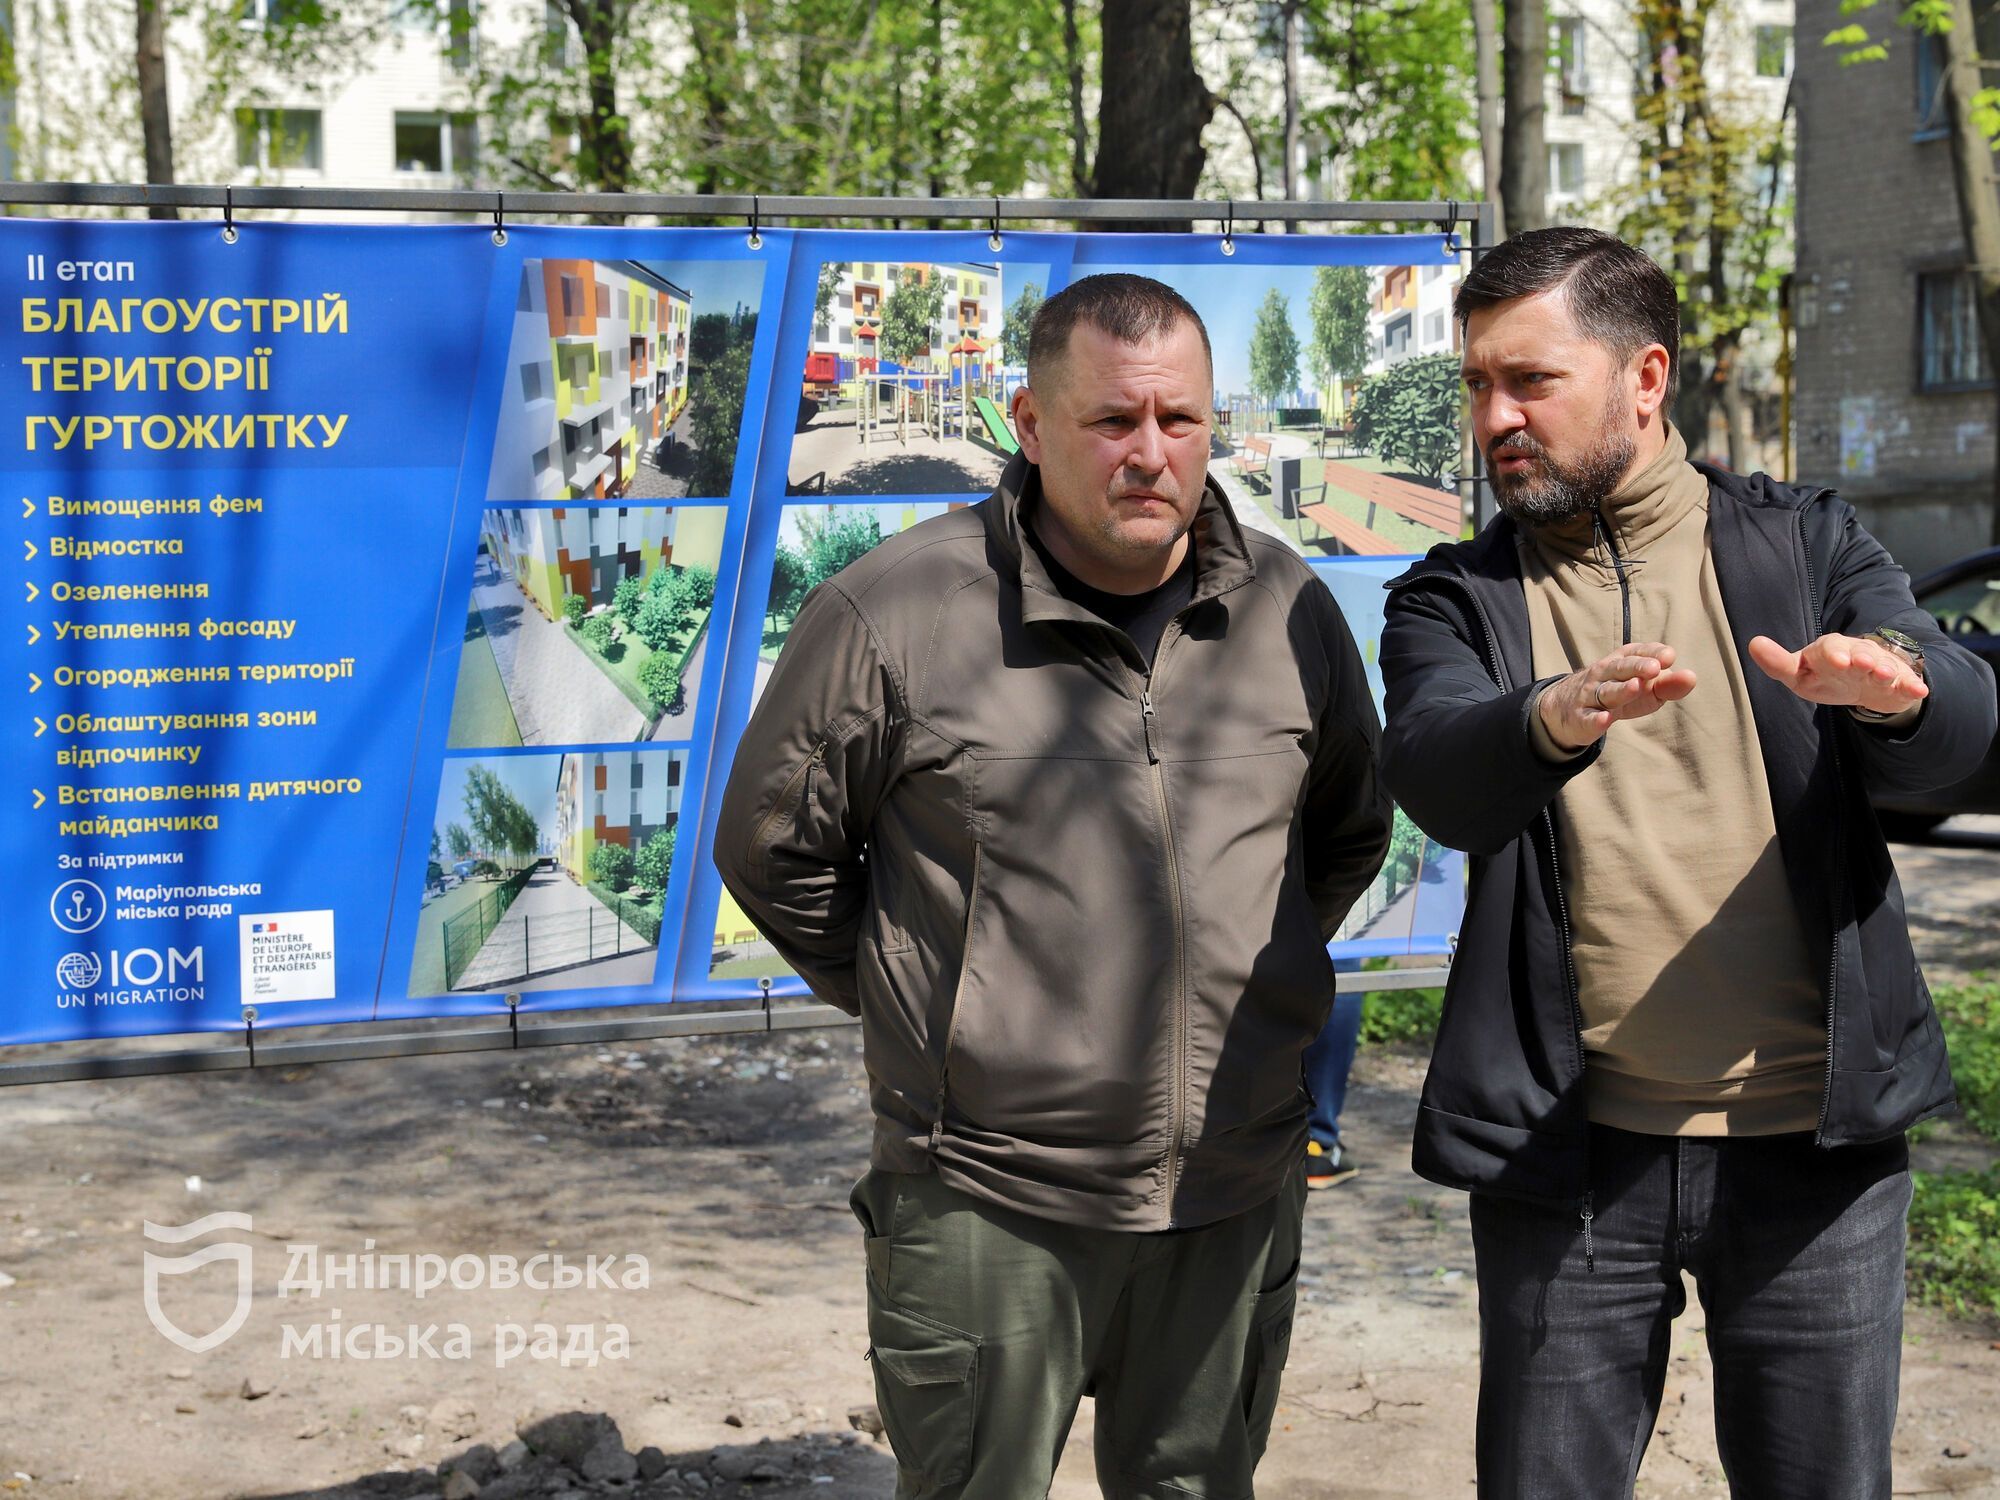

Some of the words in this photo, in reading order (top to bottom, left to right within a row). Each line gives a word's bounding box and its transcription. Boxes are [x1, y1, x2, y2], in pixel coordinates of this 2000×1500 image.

[57, 260, 135, 282] етап
[22, 293, 348, 334] БЛАГОУСТРІЙ
[22, 347, 272, 392] ТЕРИТОРІЇ
[25, 414, 349, 450] ГУРТОЖИТКУ
[48, 496, 201, 520] Вимощення
[209, 494, 263, 518] фем
[50, 537, 183, 559] Відмостка
[51, 581, 209, 602] Озеленення
[53, 619, 190, 641] Утеплення
[199, 617, 296, 640] фасаду
[54, 664, 230, 689] Огородження
[238, 658, 355, 682] території
[56, 712, 249, 737] Облаштування
[257, 708, 317, 728] зони
[57, 744, 201, 768] відпочинку
[58, 781, 240, 805] Встановлення
[248, 776, 363, 801] дитячого
[60, 812, 218, 837] майданчика
[58, 854, 82, 869] За
[89, 852, 183, 870] підтримки
[116, 882, 262, 903] Маріупольська
[117, 904, 179, 920] міська
[185, 903, 232, 919] рада
[253, 933, 304, 944] MINISTÈRE
[253, 946, 265, 954] DE
[111, 946, 203, 987] IOM
[253, 956, 264, 964] ET
[267, 954, 285, 963] DES
[288, 952, 332, 961] AFFAIRES
[253, 961, 316, 974] ÉTRANGÈRES
[57, 993, 85, 1008] UN
[95, 987, 204, 1006] MIGRATION
